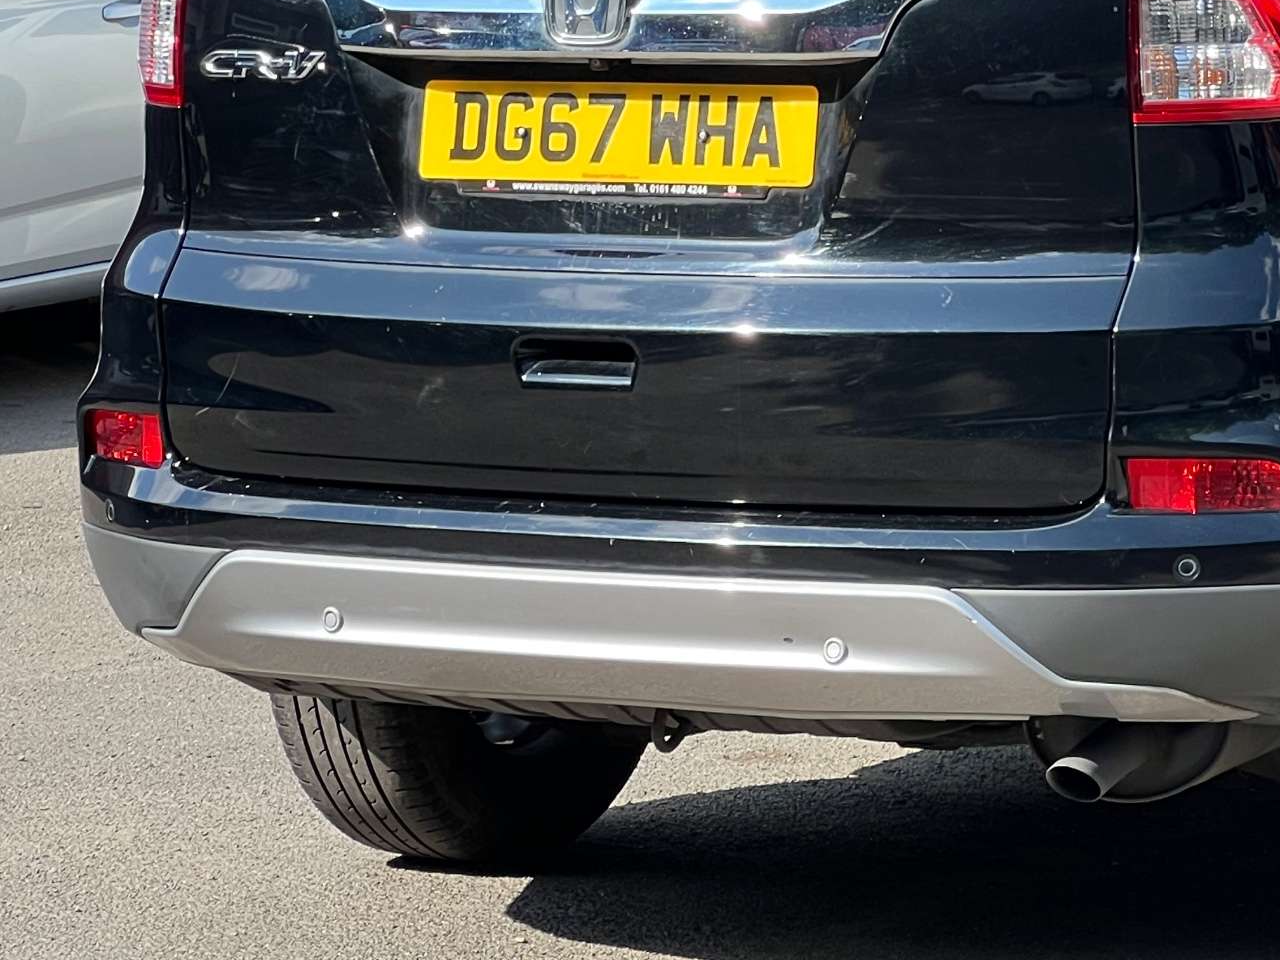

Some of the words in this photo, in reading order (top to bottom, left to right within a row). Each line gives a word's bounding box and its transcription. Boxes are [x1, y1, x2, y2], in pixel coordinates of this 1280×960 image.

[200, 49, 326, 81] CR-V
[449, 91, 627, 163] DG67
[648, 93, 781, 168] WHA
[511, 182, 626, 195] www.swanswaygarages.com
[633, 183, 648, 193] Tel.
[649, 184, 669, 194] 0161
